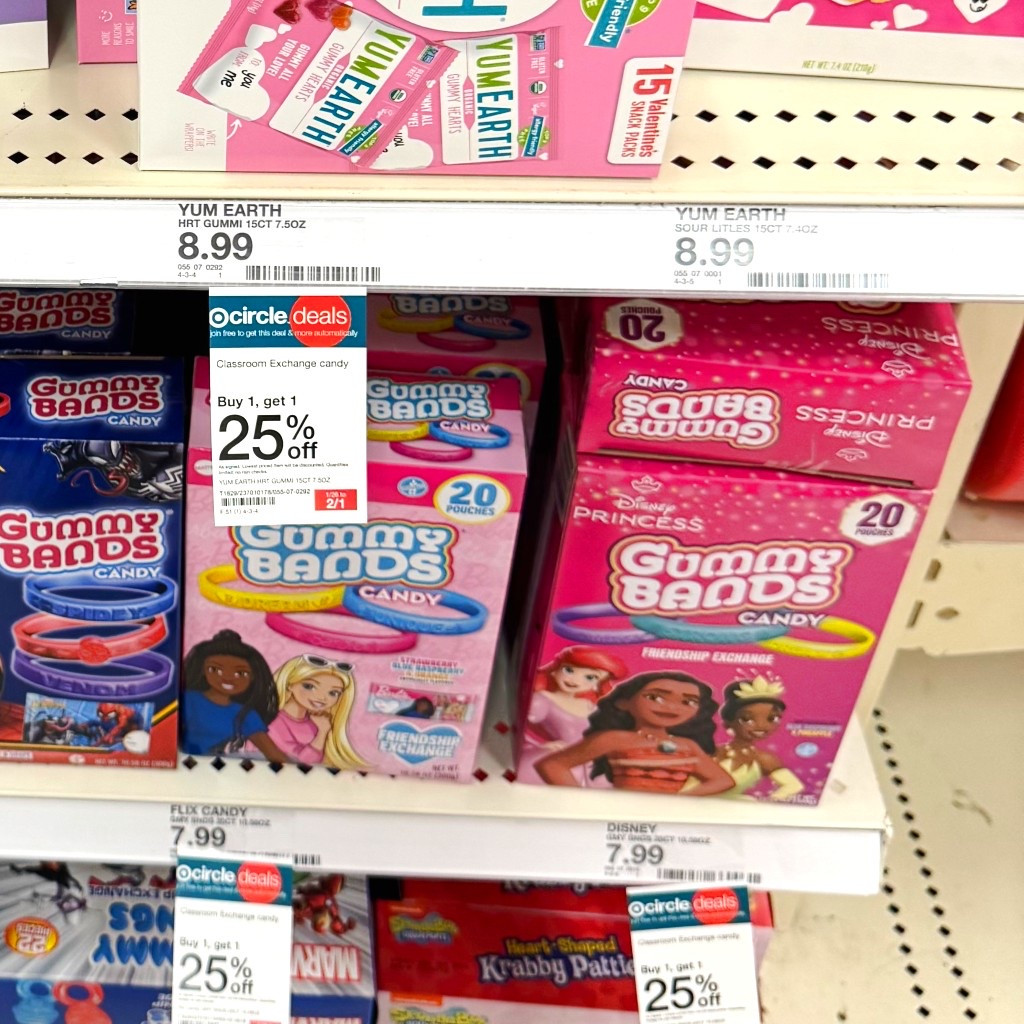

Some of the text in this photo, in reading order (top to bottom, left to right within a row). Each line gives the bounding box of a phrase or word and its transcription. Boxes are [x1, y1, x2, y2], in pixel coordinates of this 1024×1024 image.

[632, 63, 675, 158] 15 Valentine's
[621, 100, 646, 158] SNACK PACKS
[178, 203, 282, 217] YUM EARTH
[675, 207, 786, 221] YUM EARTH
[178, 219, 307, 229] HRT GUMMI 15CT 7.5OZ
[674, 223, 708, 233] SOUR
[712, 224, 751, 233] LITLES
[755, 224, 781, 234] 15CT
[178, 231, 254, 260] 8.99
[674, 236, 755, 267] 8.99
[229, 305, 348, 325] circle deals
[216, 359, 349, 370] Classroom Exchange candy
[217, 396, 244, 409] Buy
[263, 396, 286, 409] get
[287, 442, 319, 460] off
[449, 482, 498, 506] 20
[445, 505, 495, 516] POUCHES
[573, 505, 705, 532] PRINCESS
[856, 502, 904, 529] 20
[94, 566, 161, 579] CANDY
[641, 646, 774, 666] FRIENDSHIP EXCHANGE
[170, 804, 248, 818] FLIX CANDY
[171, 825, 227, 847] 7.99
[607, 823, 658, 834] DISNEY
[605, 843, 664, 865] 7.99
[478, 955, 567, 985] Krabby
